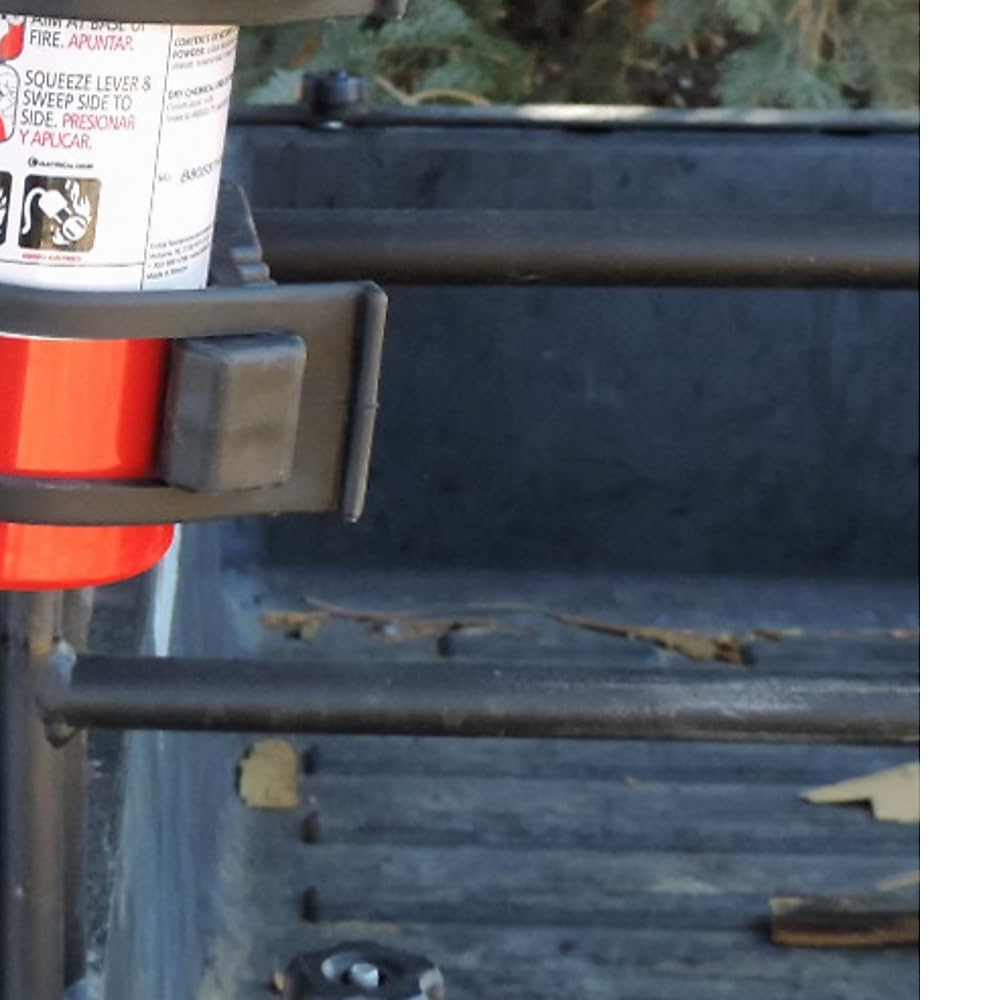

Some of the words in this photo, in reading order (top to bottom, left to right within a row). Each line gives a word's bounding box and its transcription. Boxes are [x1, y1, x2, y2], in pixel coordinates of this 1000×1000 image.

[30, 28, 64, 48] FIRE.
[23, 69, 92, 91] SQUEEZE
[96, 76, 137, 92] LEVER
[23, 89, 72, 110] SWEEP
[77, 93, 111, 110] SIDE
[114, 95, 132, 111] TO
[20, 109, 58, 128] SIDE.
[62, 112, 135, 131] PRESIONAR
[19, 130, 29, 145] Y
[30, 131, 92, 150] APLICAR.
